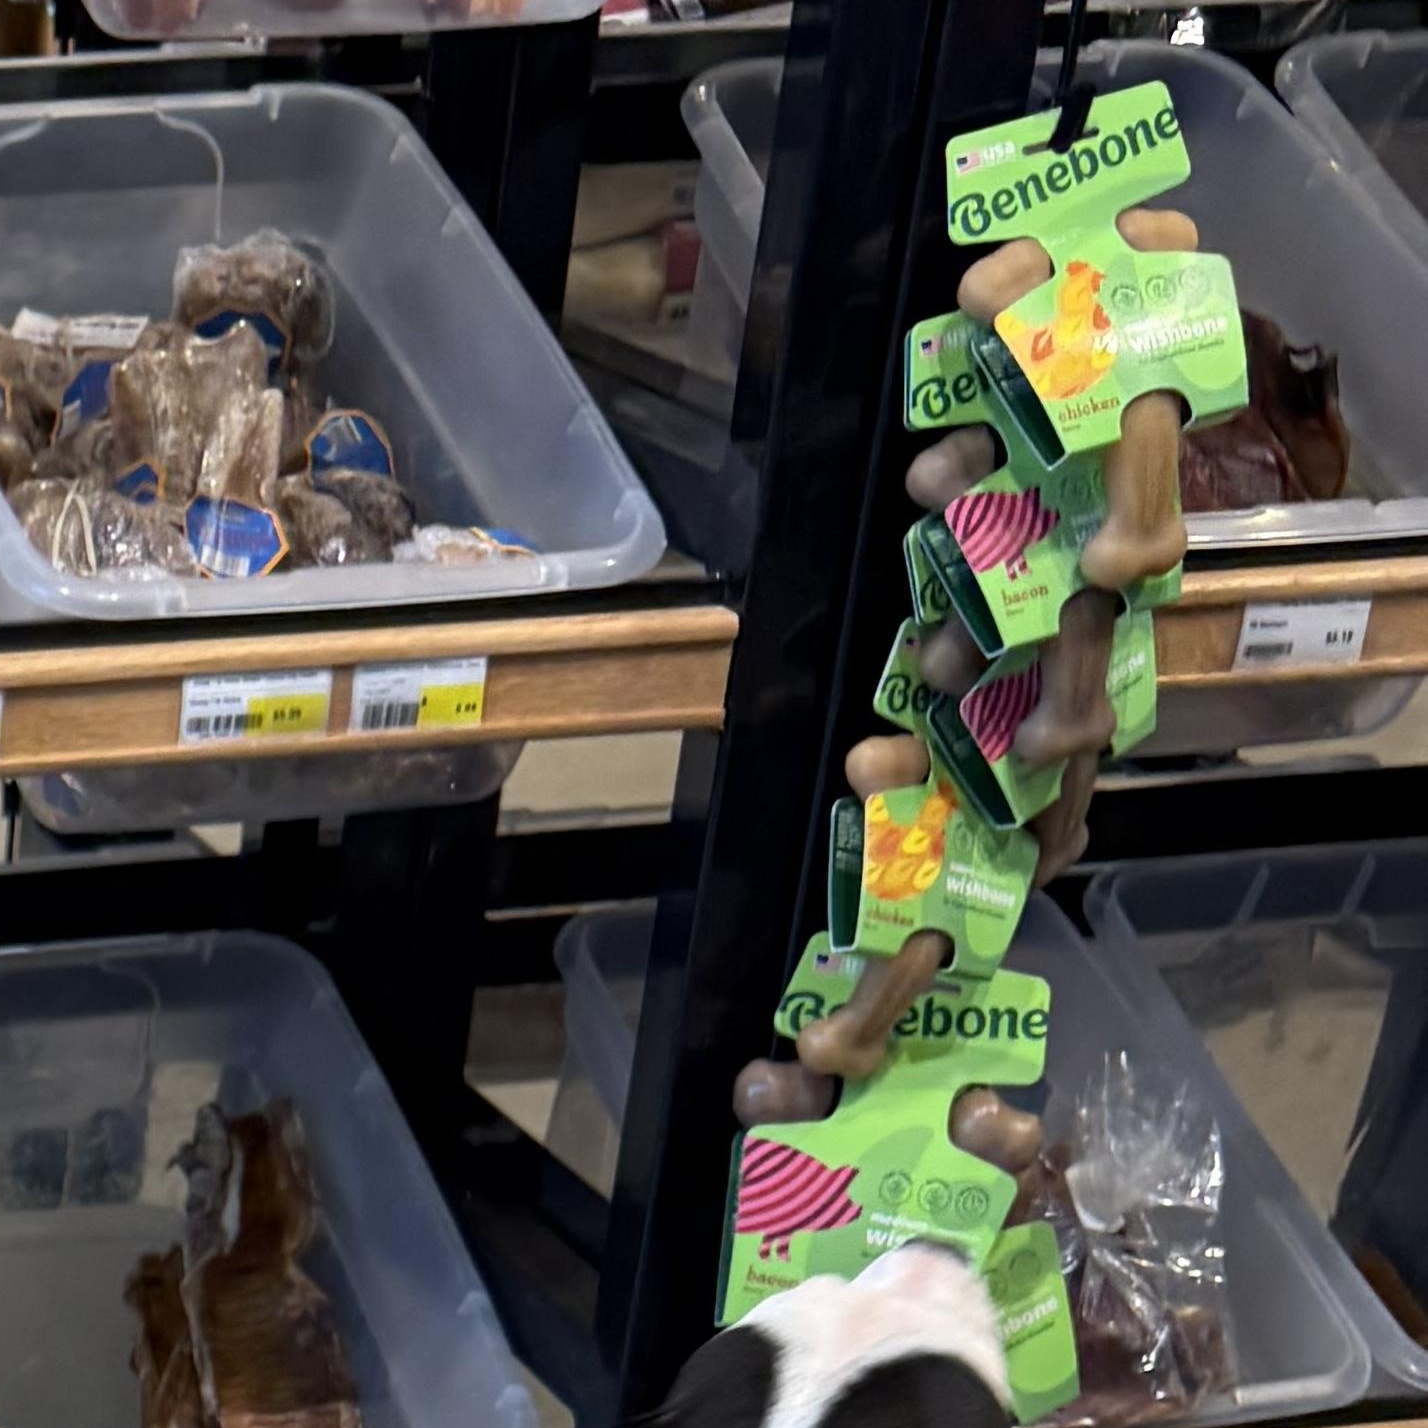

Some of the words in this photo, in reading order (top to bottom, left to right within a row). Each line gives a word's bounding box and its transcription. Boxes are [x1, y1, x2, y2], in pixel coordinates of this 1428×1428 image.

[950, 106, 1180, 237] Benebone
[1002, 585, 1049, 607] bacon
[777, 991, 1049, 1040] Bebone
